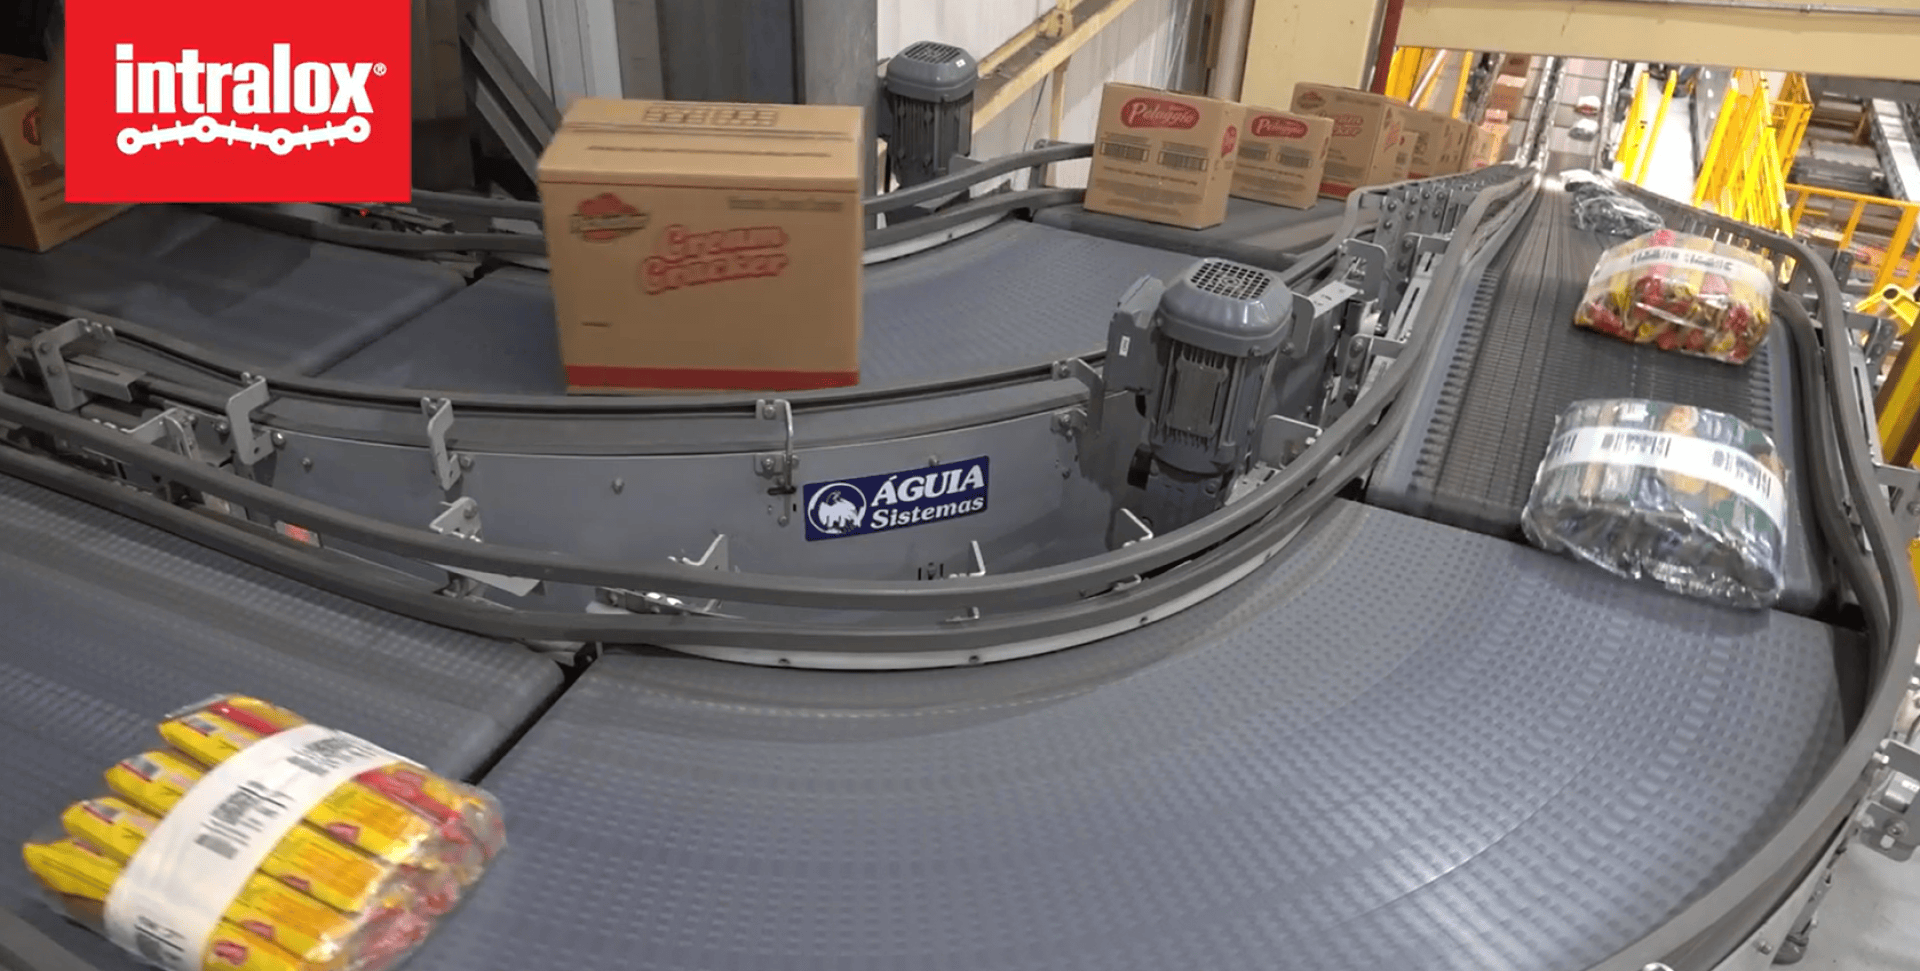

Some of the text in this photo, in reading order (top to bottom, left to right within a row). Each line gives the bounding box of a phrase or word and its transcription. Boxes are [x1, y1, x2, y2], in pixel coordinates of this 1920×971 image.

[661, 223, 790, 260] Cream
[641, 253, 790, 295] Cracker
[870, 464, 985, 507] ÁGUIA
[870, 497, 984, 529] Sistemas
